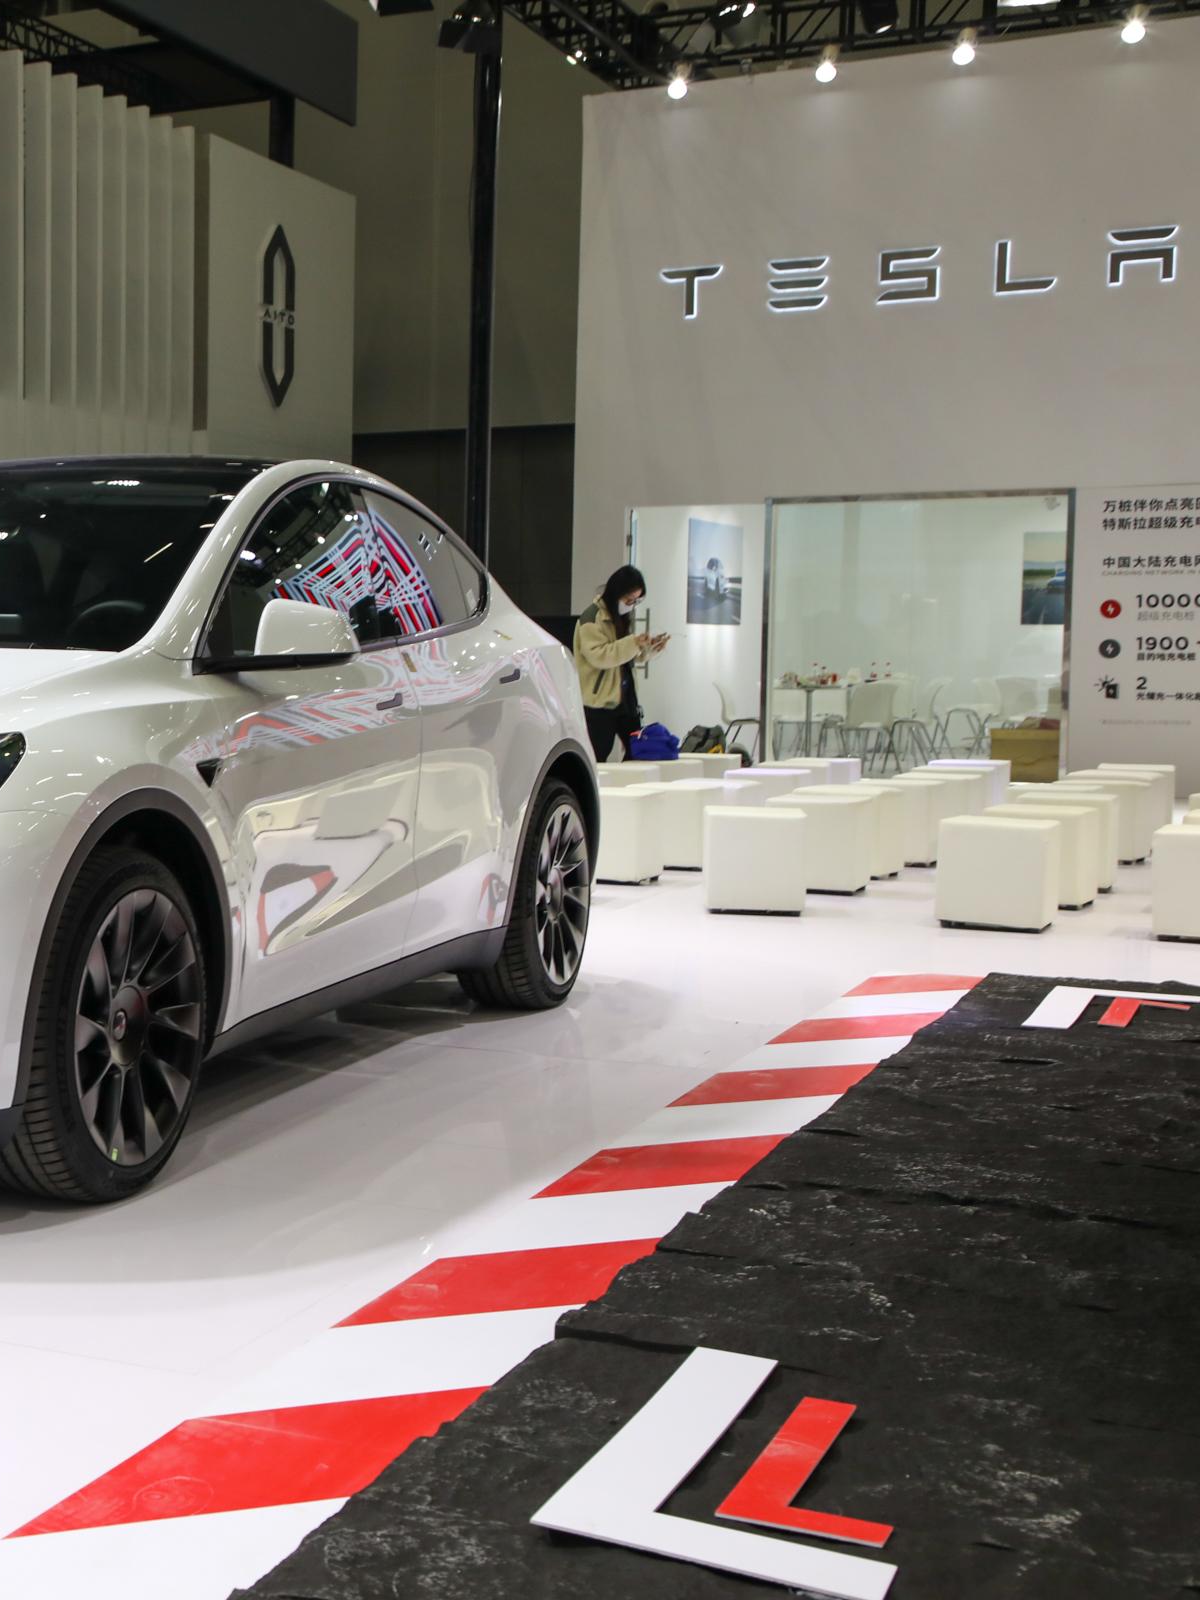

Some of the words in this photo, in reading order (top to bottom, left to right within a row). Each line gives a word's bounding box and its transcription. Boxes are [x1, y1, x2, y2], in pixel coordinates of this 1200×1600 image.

[660, 224, 1180, 320] TESLA
[264, 308, 295, 326] AITO
[1136, 636, 1189, 650] 1900
[1136, 676, 1147, 690] 2
